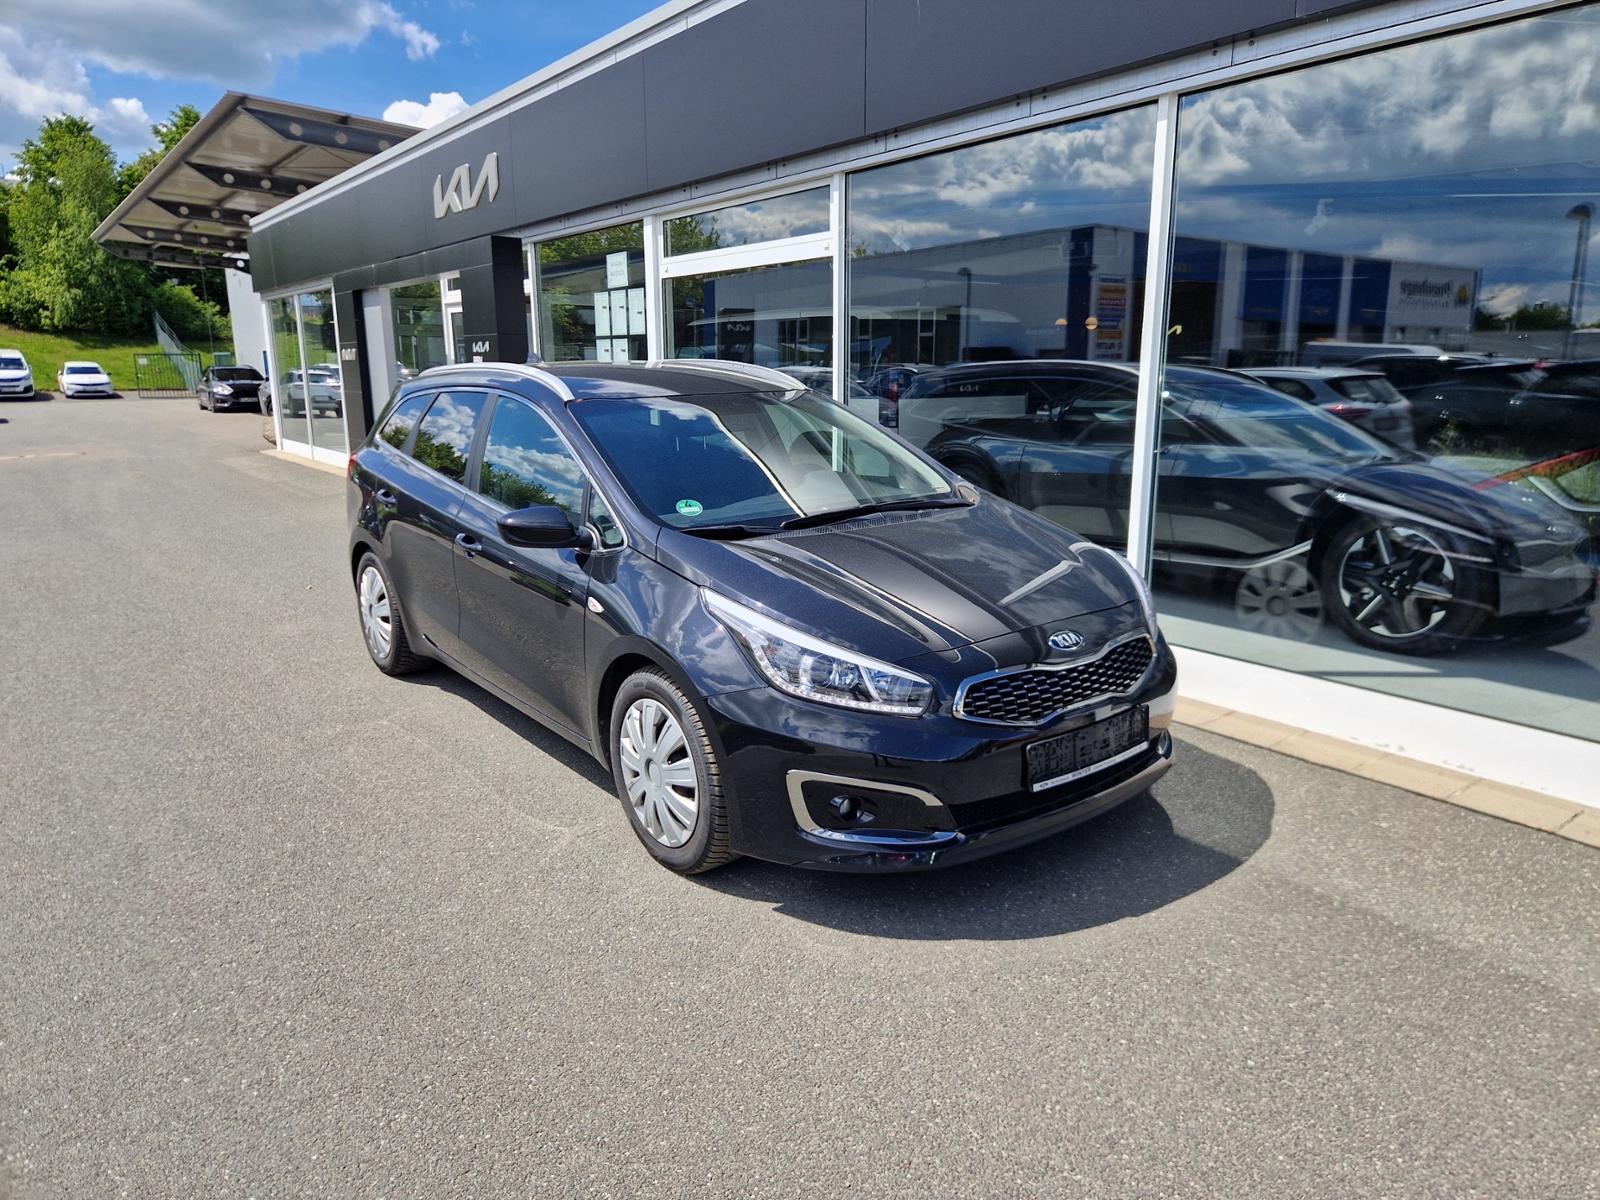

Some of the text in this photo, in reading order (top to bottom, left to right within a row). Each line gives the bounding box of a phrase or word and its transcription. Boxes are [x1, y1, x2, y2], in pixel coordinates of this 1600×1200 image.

[433, 152, 498, 219] KIA
[472, 341, 490, 353] KIA
[1054, 632, 1081, 648] KIA
